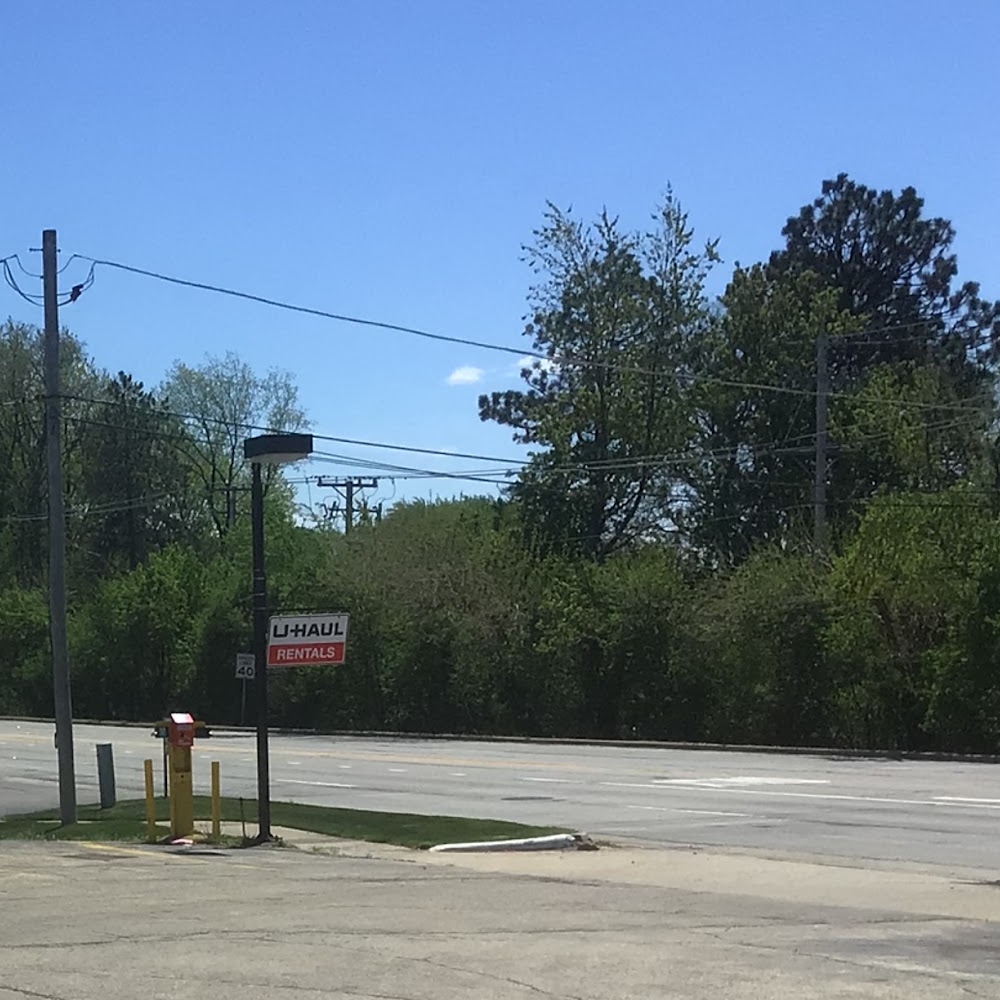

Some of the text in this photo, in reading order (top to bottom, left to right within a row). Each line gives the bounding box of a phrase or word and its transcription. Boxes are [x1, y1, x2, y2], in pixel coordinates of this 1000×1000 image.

[273, 622, 344, 638] U-HAUL
[276, 646, 335, 661] RENTALS
[237, 666, 254, 677] 40
